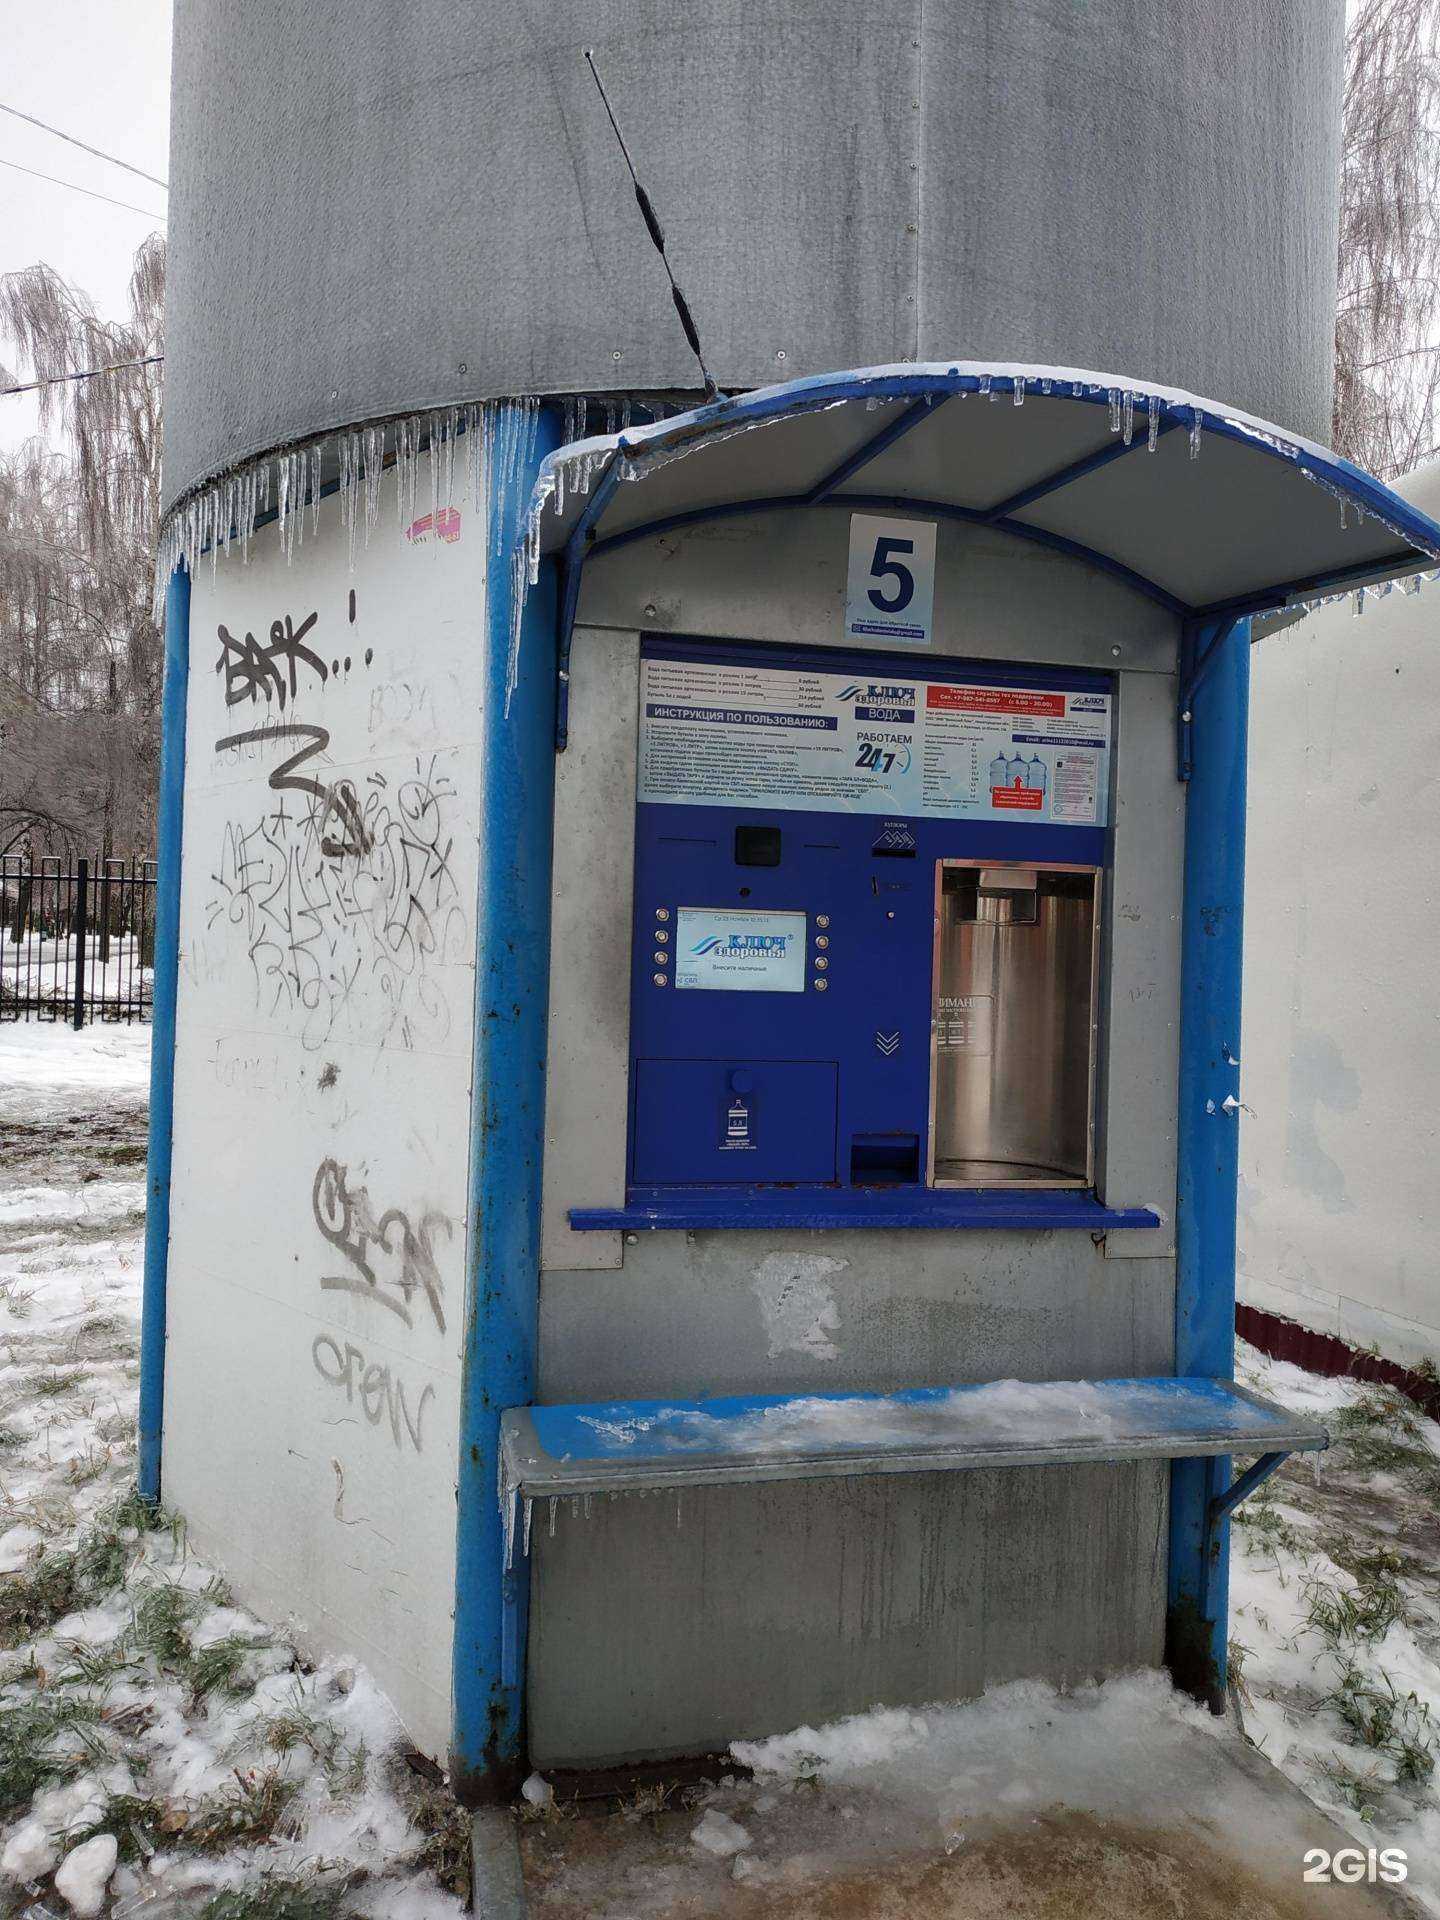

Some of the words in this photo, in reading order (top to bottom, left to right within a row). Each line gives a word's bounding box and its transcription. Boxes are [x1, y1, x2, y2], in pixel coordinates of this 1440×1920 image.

[868, 537, 914, 613] 5
[868, 685, 916, 700] КЛЮЧ
[655, 707, 724, 721] ИНСТРУКЦИЯ
[727, 712, 741, 722] ПО
[744, 713, 829, 729] ПОЛЬЗОВАНИЮ:
[869, 708, 901, 720] ВОДА
[857, 732, 913, 744] РАБОТАЕМ
[728, 935, 787, 949] КЛЮЧ
[715, 947, 786, 959] здоровья
